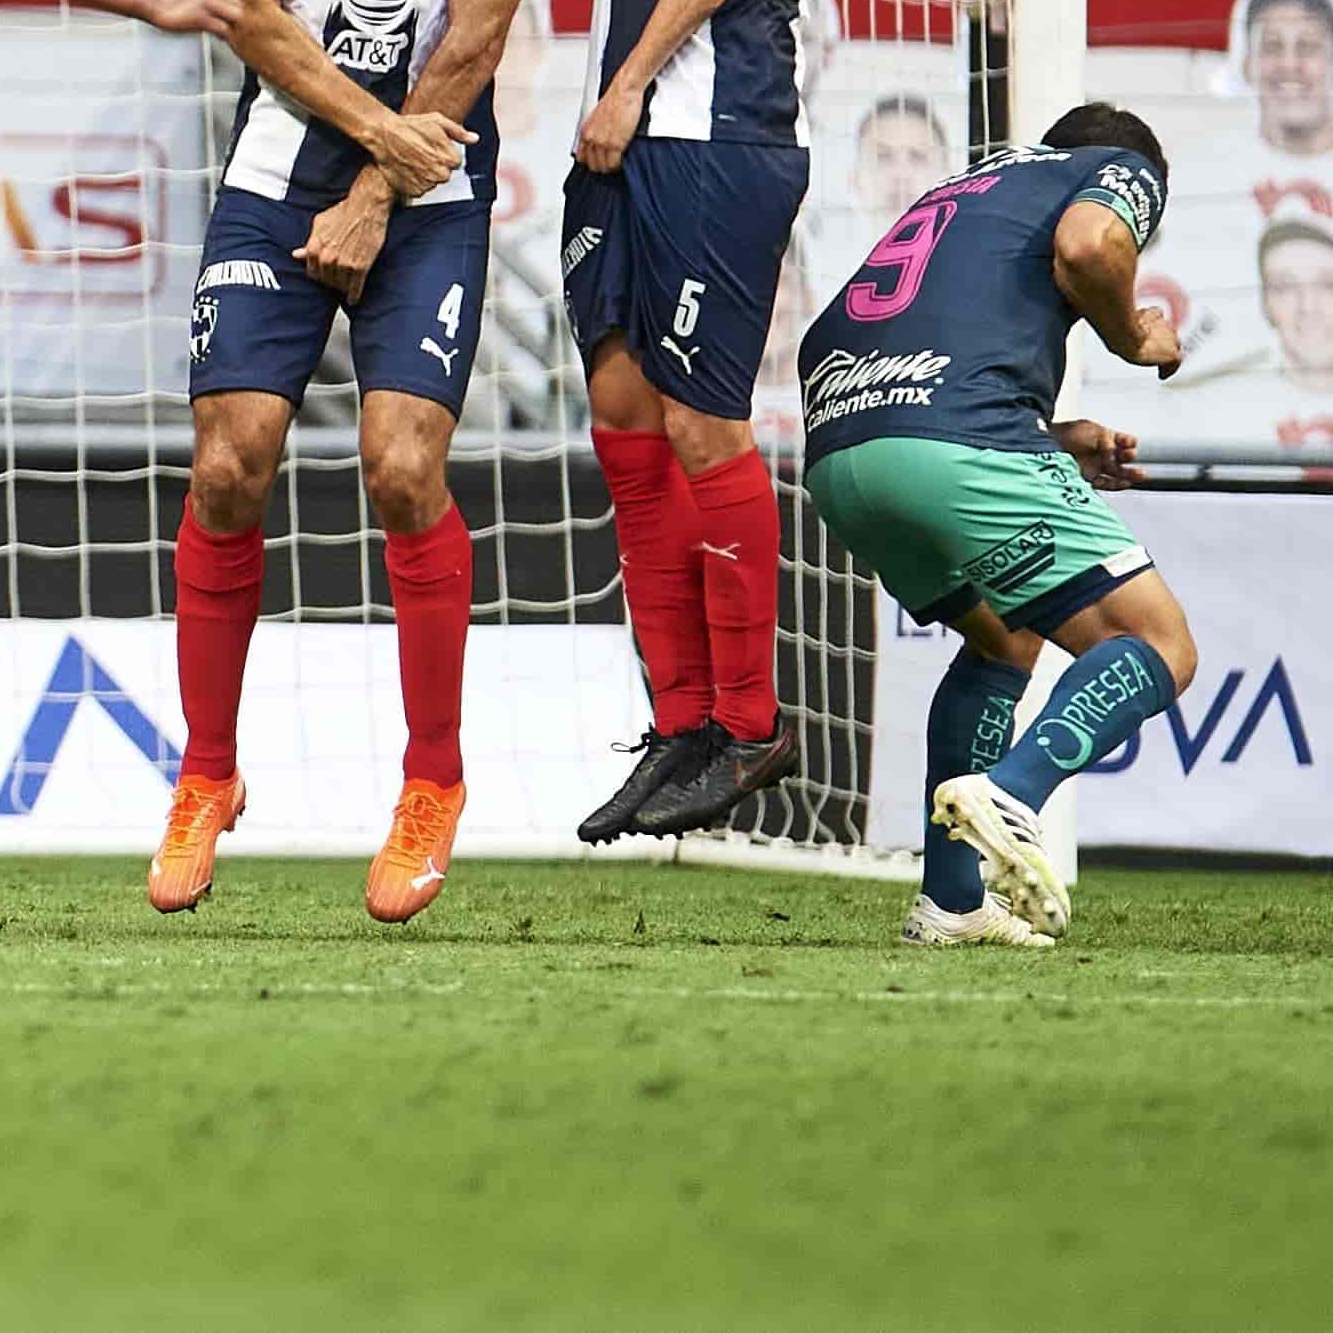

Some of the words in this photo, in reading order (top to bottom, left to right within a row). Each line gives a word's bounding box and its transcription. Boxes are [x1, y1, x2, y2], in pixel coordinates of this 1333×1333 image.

[332, 36, 401, 65] AT&T
[845, 200, 958, 323] 9
[437, 282, 465, 339] 4
[672, 277, 707, 338] 5
[807, 386, 934, 433] caliente.mx
[1067, 650, 1153, 735] PRESEA
